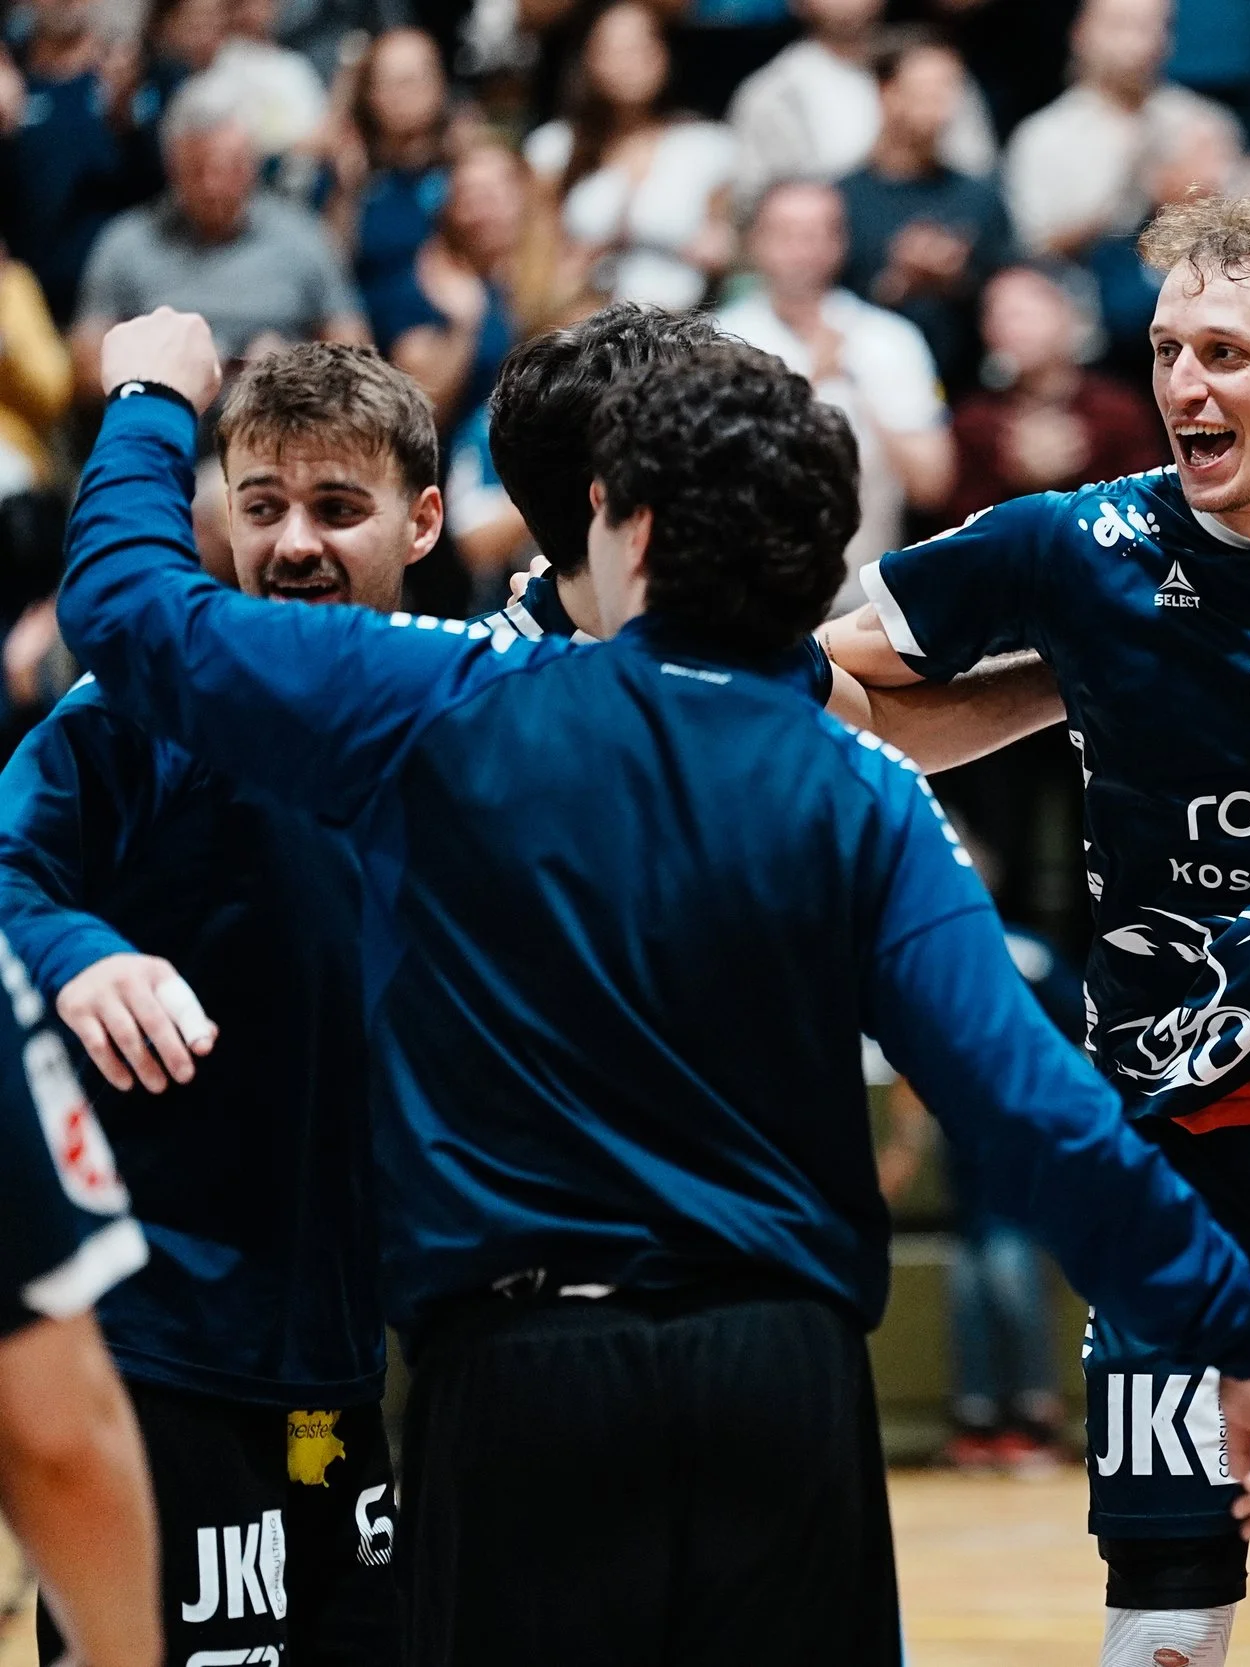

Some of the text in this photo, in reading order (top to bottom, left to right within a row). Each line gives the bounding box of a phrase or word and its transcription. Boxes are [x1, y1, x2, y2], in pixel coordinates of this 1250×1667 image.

[1154, 593, 1201, 609] SELECT
[1095, 1373, 1194, 1476] JK
[355, 1483, 394, 1566] 6
[182, 1523, 268, 1623] JK
